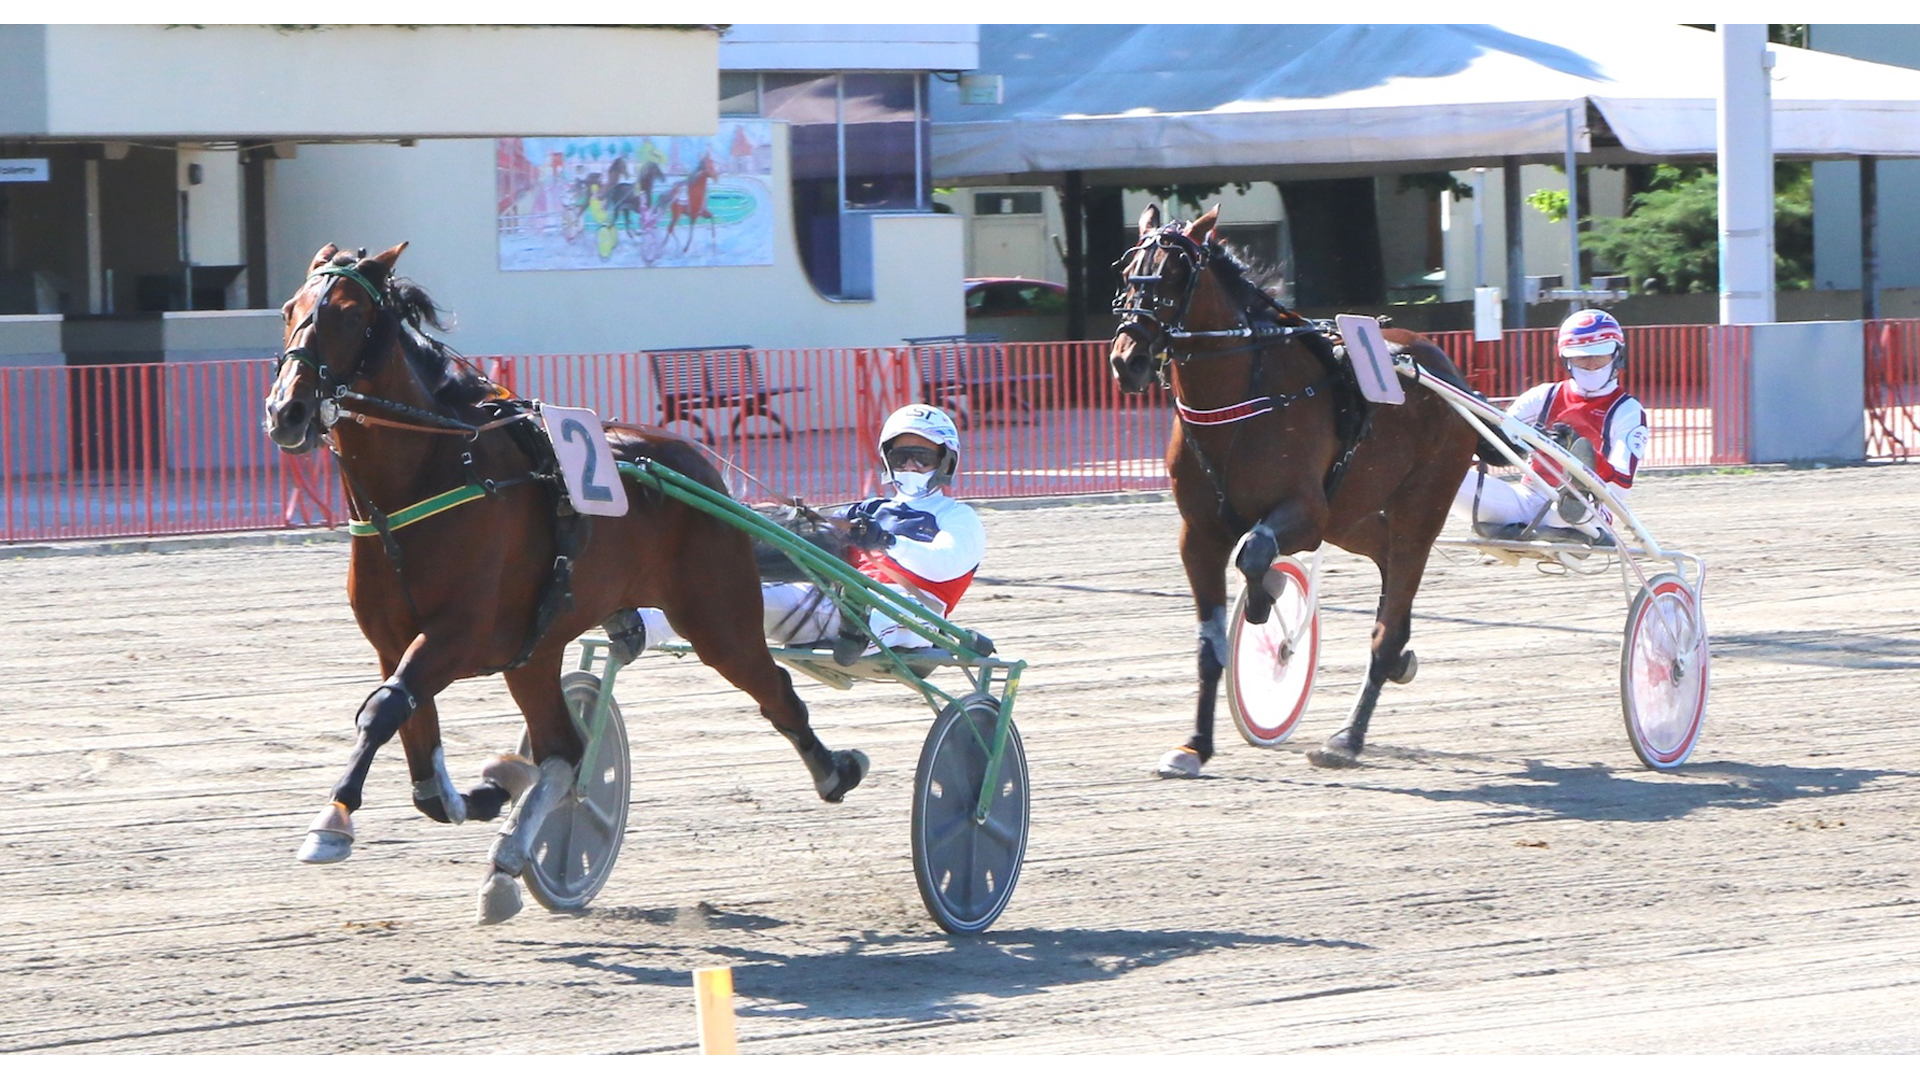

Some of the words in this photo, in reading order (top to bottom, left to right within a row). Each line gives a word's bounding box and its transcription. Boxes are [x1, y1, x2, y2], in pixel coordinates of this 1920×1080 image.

[1357, 325, 1388, 392] 1
[906, 407, 937, 420] ST
[560, 418, 614, 503] 2
